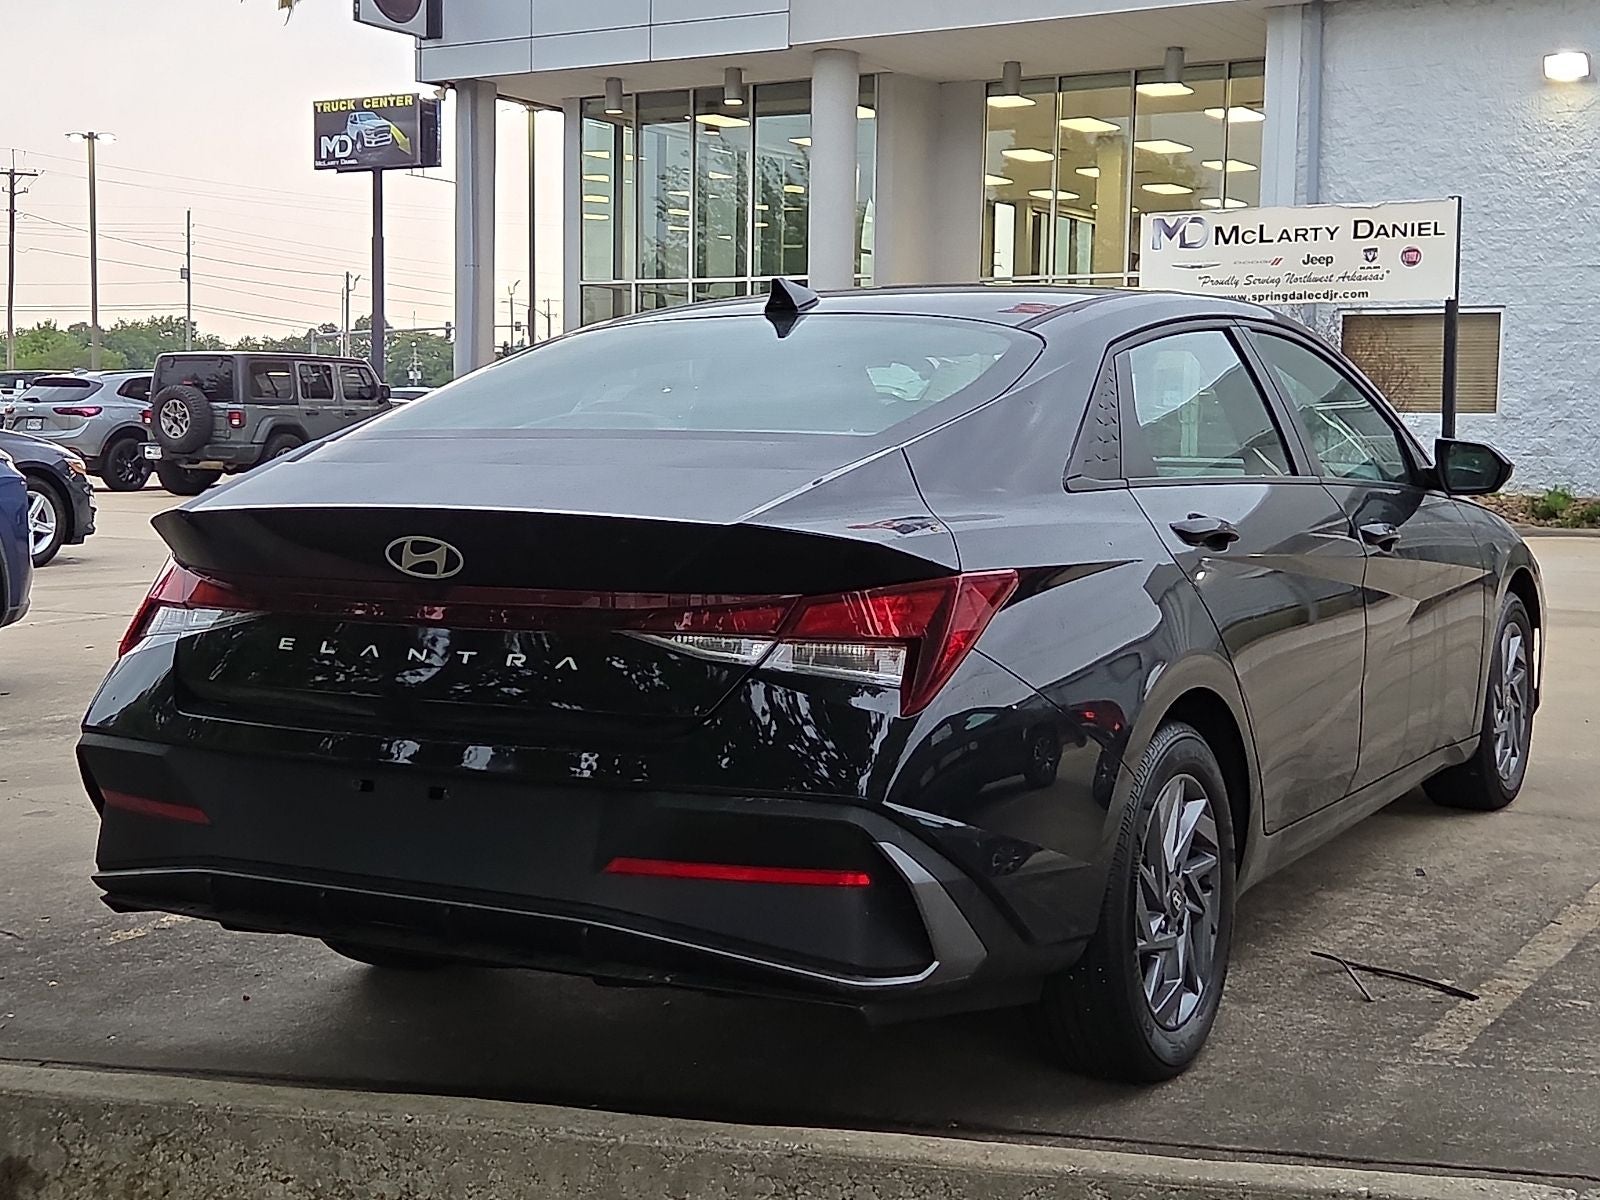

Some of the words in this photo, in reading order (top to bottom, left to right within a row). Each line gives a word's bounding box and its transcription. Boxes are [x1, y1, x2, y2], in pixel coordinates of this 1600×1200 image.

[315, 100, 356, 113] TRUCK
[363, 95, 413, 109] CENTER
[320, 134, 353, 159] MD
[1151, 216, 1210, 250] MD
[1352, 219, 1446, 240] DANIEL
[1301, 253, 1334, 267] Jeep
[1243, 274, 1281, 287] Serving
[1284, 271, 1334, 285] Northwest
[1225, 289, 1369, 301] ww.springdalecdjr.com
[278, 636, 578, 671] ELANTRA
